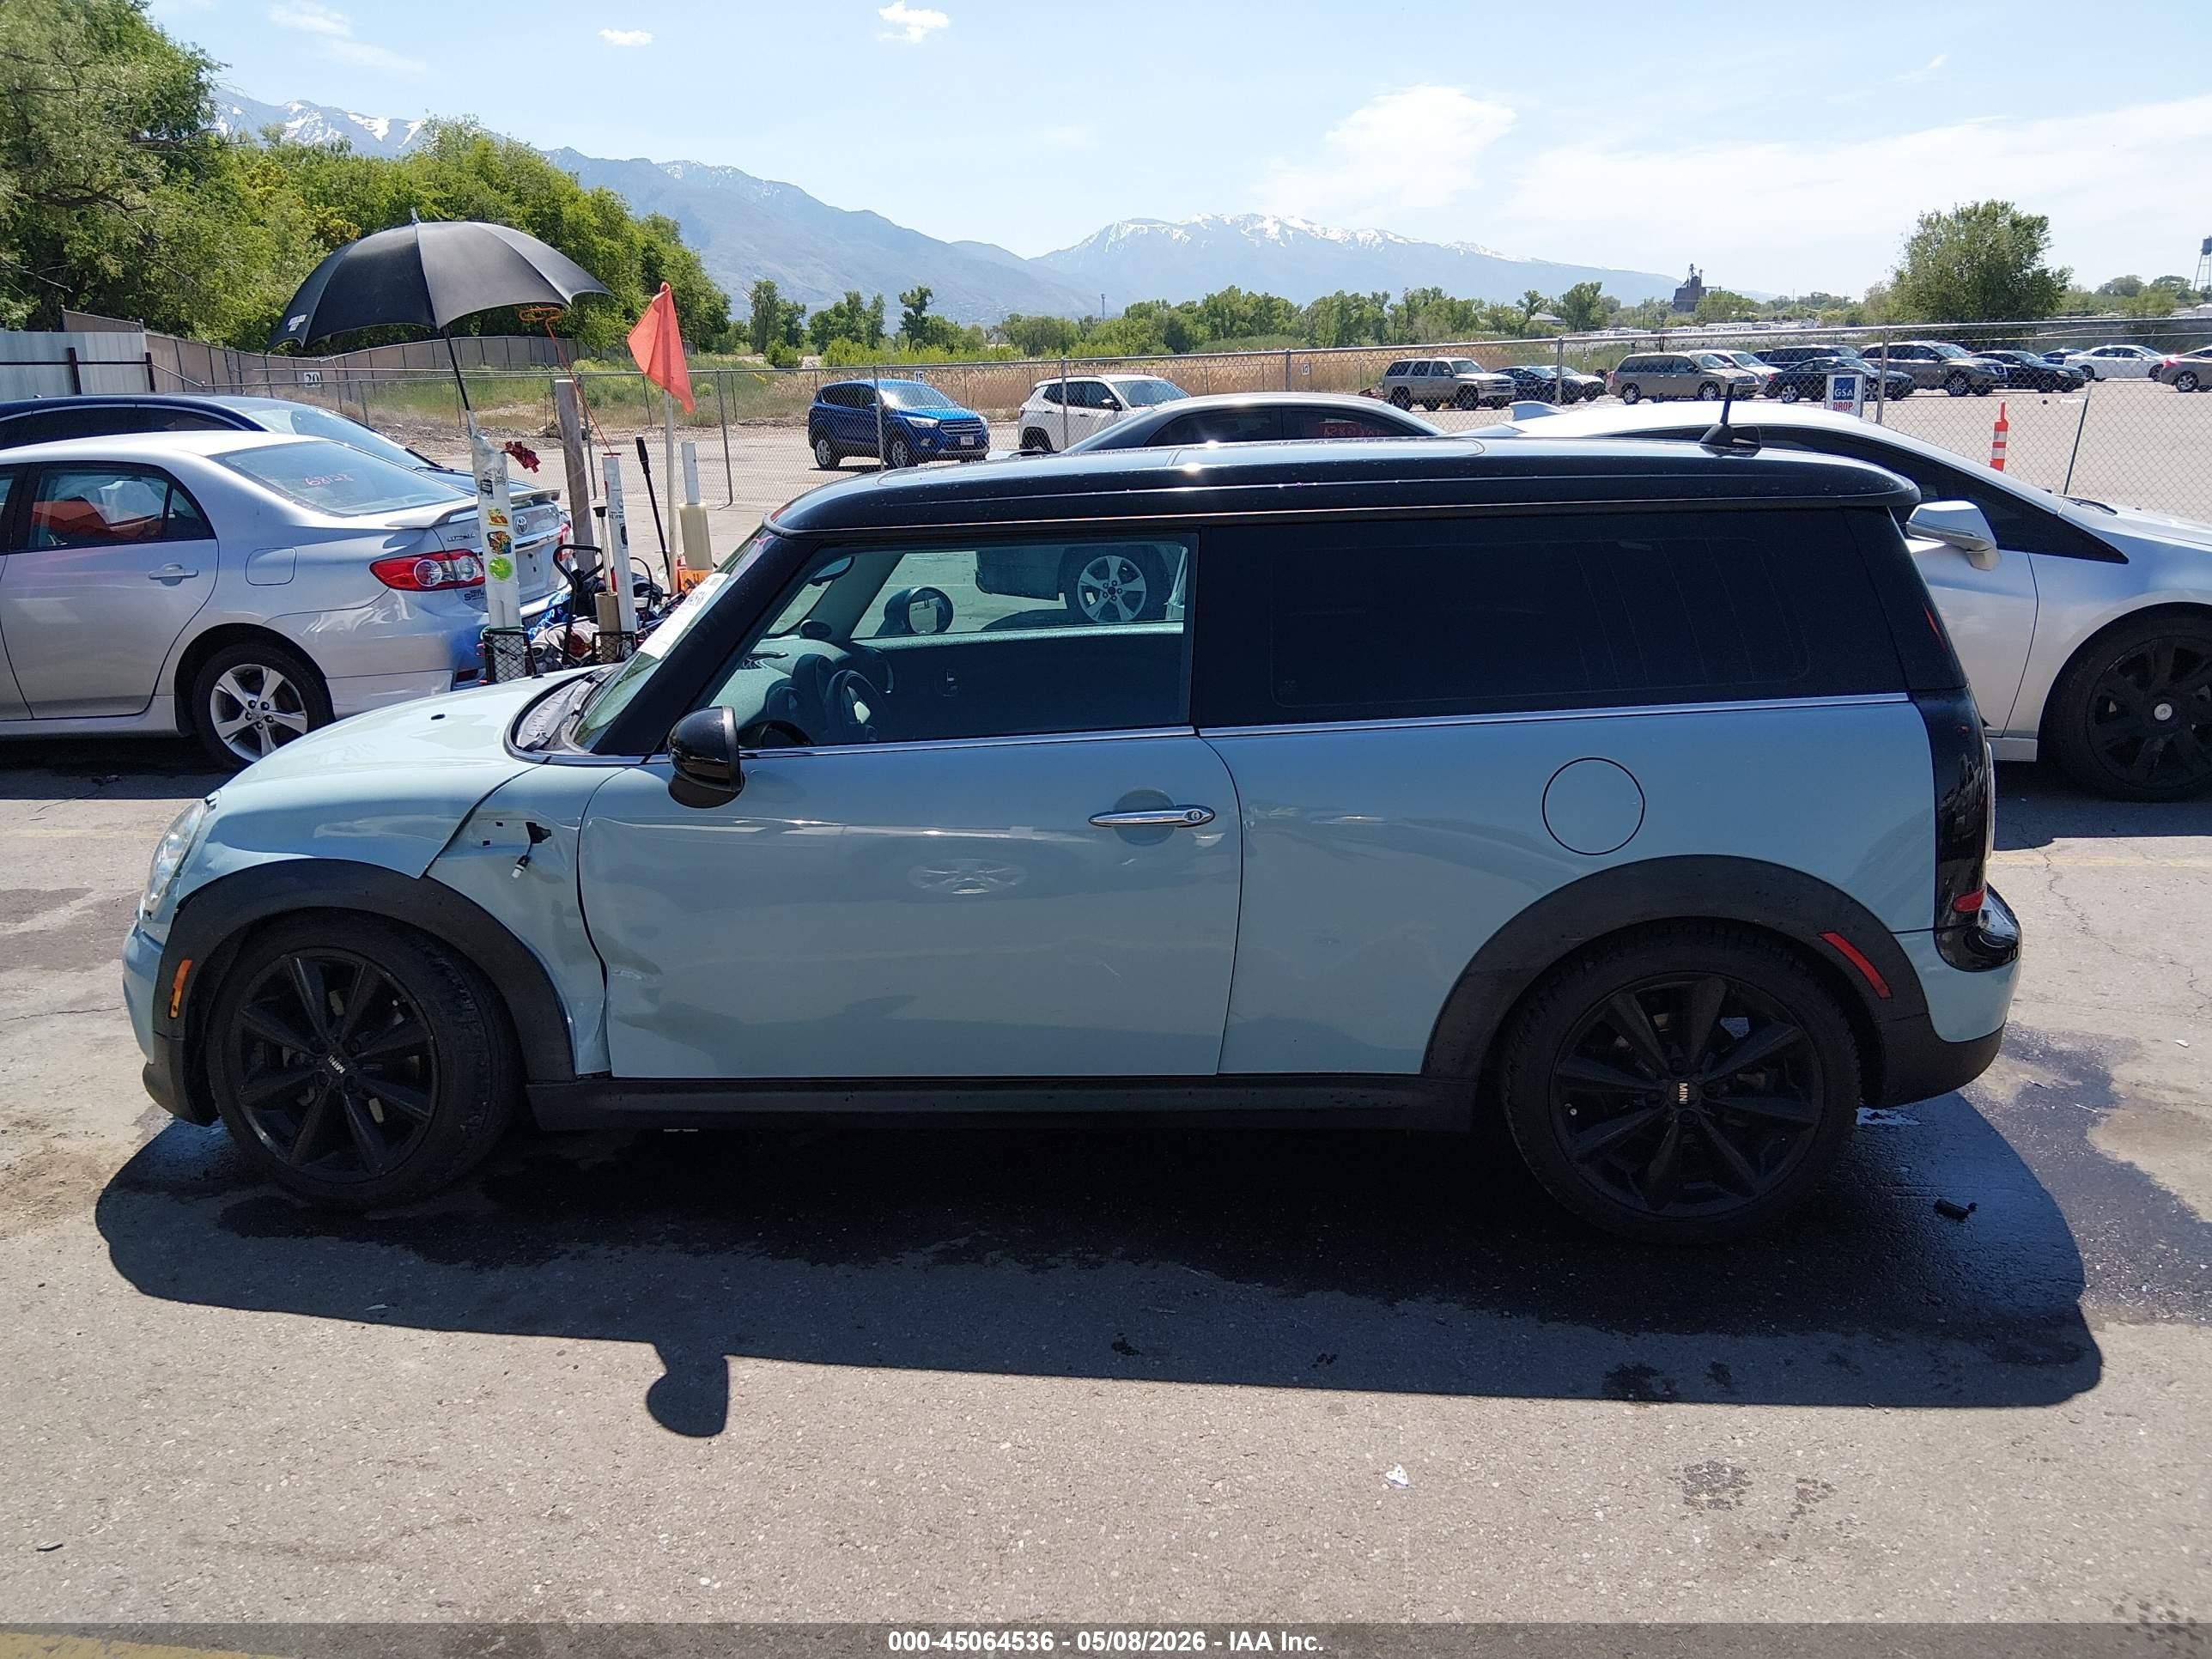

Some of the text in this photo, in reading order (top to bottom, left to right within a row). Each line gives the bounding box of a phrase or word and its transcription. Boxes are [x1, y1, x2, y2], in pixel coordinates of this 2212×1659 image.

[306, 374, 319, 386] 20
[915, 372, 924, 383] 15
[1834, 388, 1854, 398] GSA
[1832, 401, 1854, 412] DROP
[1679, 1083, 1688, 1104] MINI
